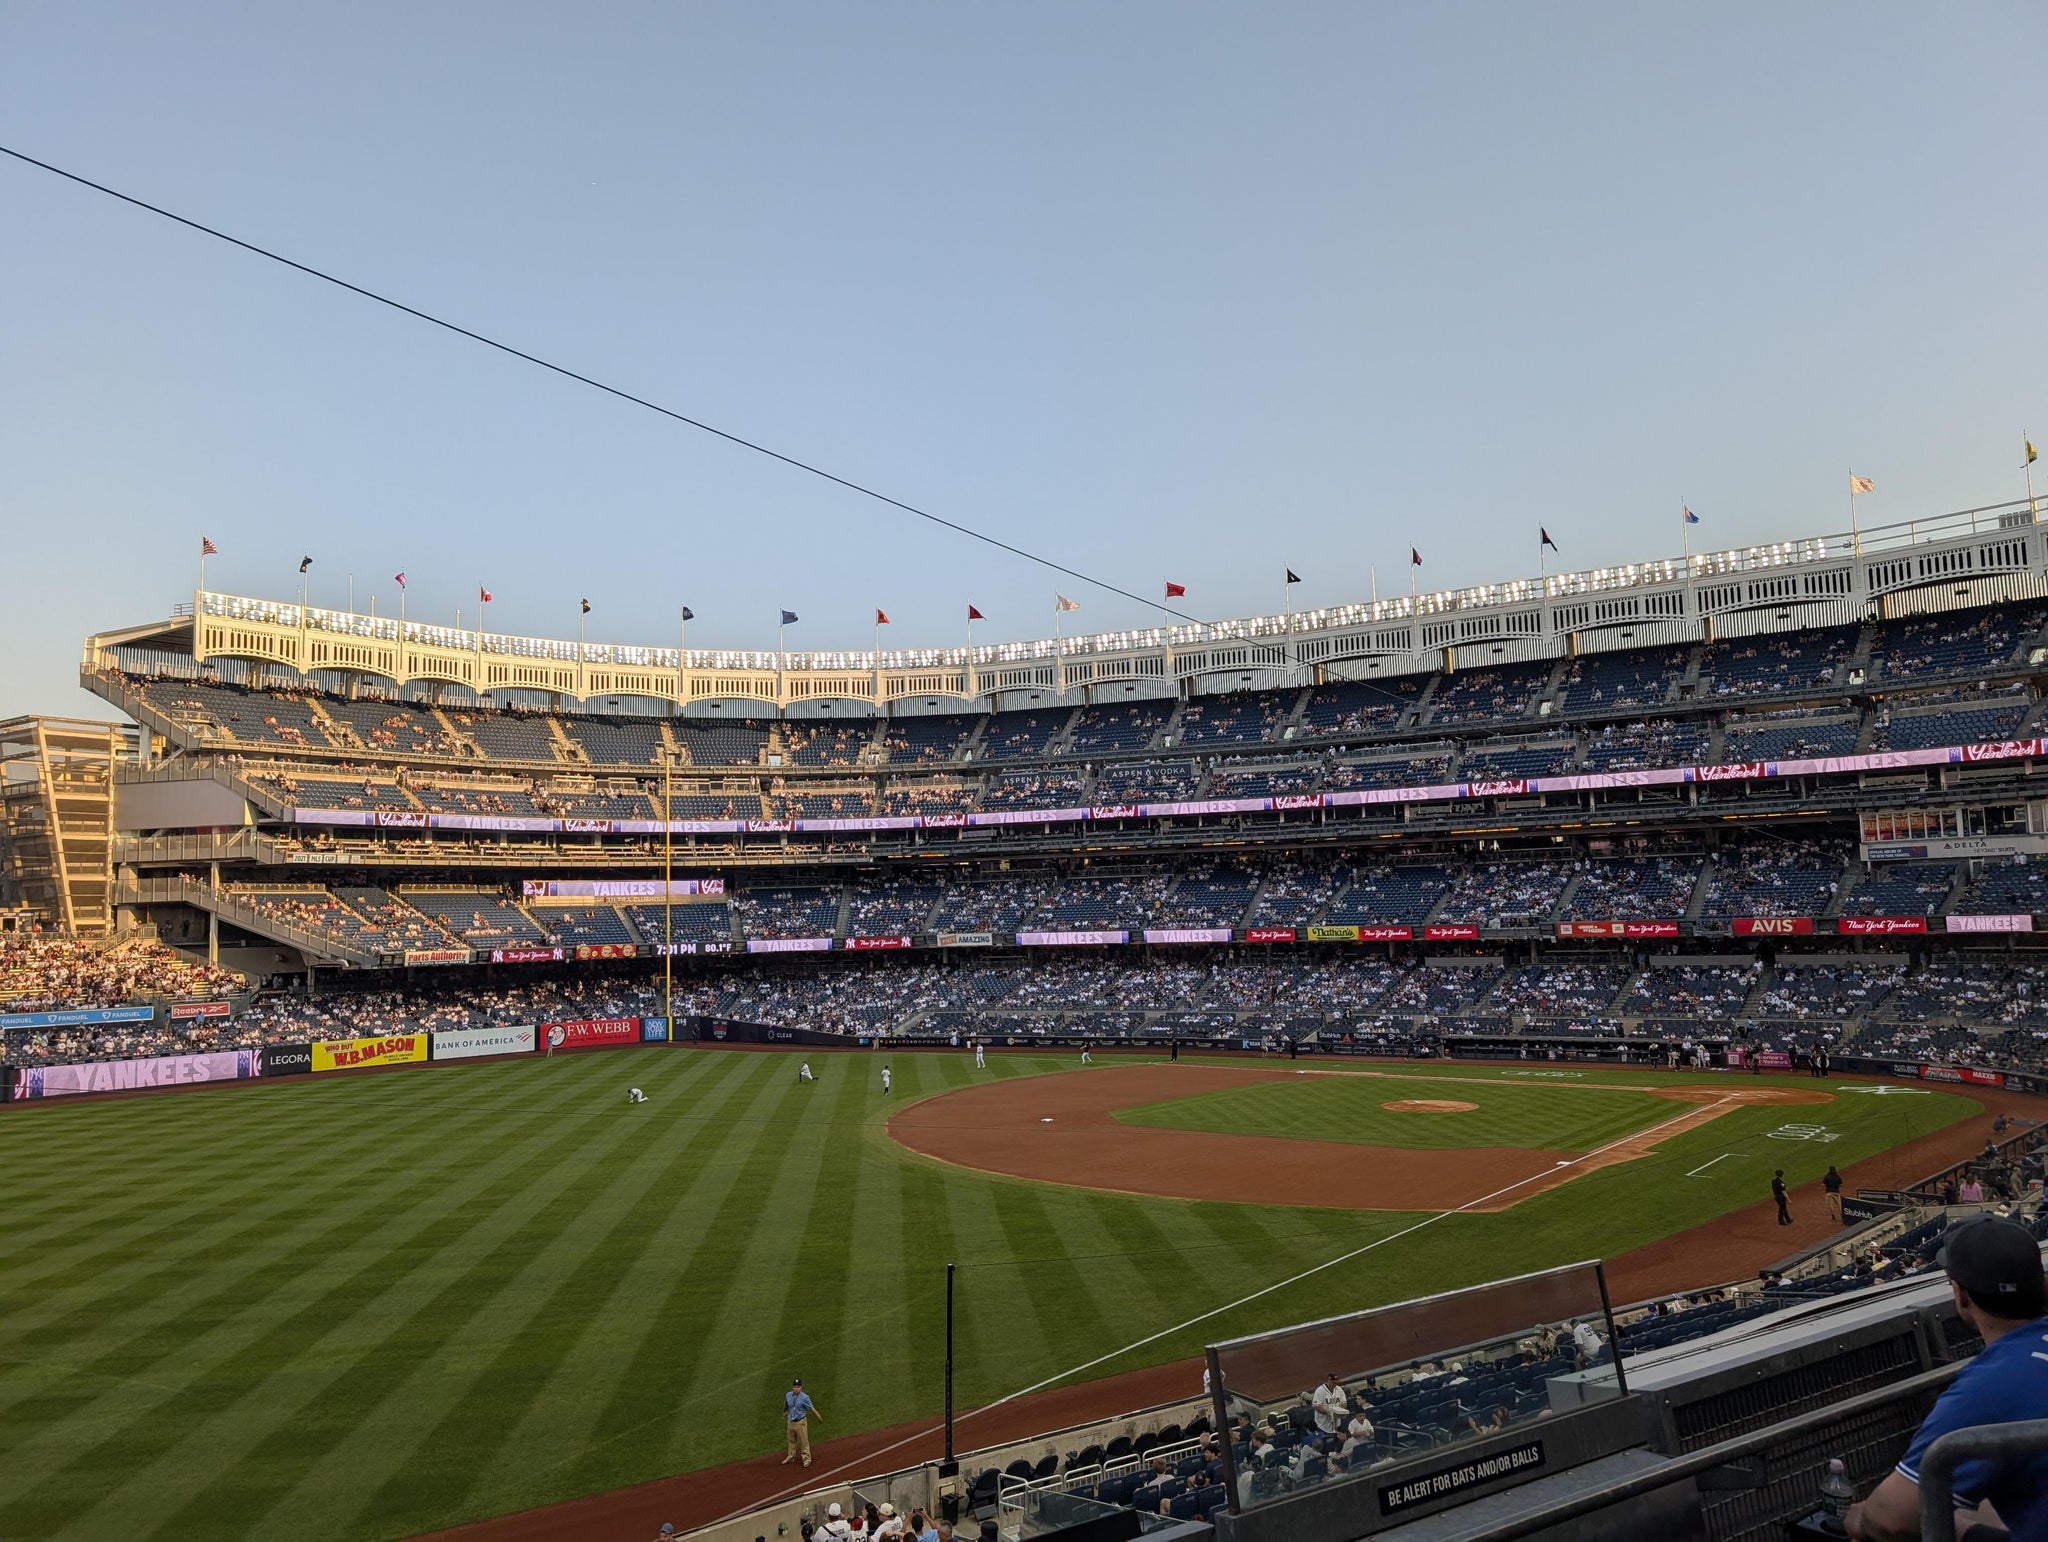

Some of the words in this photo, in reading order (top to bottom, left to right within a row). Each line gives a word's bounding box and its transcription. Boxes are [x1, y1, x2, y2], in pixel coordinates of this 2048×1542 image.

[1967, 740, 2036, 760] Yankees
[1815, 752, 1909, 773] YANKEES
[1112, 769, 1143, 778] ASPEN
[1154, 767, 1186, 776] VODKA
[1700, 763, 1759, 780] Yankees
[1003, 776, 1032, 784] ASPEN
[1568, 772, 1649, 790] YANKEES
[1472, 780, 1523, 796] Yankees
[1276, 794, 1320, 809] Yankees
[1359, 787, 1428, 804] YANKEES
[1172, 801, 1236, 815] YANKEES
[379, 813, 425, 827] Yankees
[999, 810, 1057, 823] YANKEES
[465, 817, 526, 830] YANKEES
[646, 821, 710, 832] YANKEES
[829, 818, 889, 830] YANKEES
[1954, 841, 1987, 849] DELTA
[593, 882, 656, 896] YANKEES
[1640, 925, 1653, 934] York
[1654, 924, 1677, 934] Yankees
[1751, 919, 1793, 932] AVIS
[1846, 920, 1865, 929] New
[1865, 920, 1885, 932] York
[1886, 919, 1920, 933] Yankees
[1958, 916, 2020, 930] YANKEES
[1040, 932, 1103, 944] YANKEES
[1162, 930, 1213, 942] YANKEES
[1261, 931, 1272, 940] York
[1272, 931, 1291, 940] Yankees
[1313, 927, 1354, 937] Nathan's
[1375, 929, 1387, 938] York
[1387, 929, 1408, 938] Yankees
[1441, 928, 1452, 937] York
[1452, 928, 1473, 937] Yankees
[766, 938, 814, 951] YANKEES
[958, 935, 990, 944] AMAZING
[680, 943, 697, 954] PM
[408, 953, 429, 961] Parts
[430, 951, 467, 961] Authority
[112, 1011, 141, 1019] FANDUEL
[173, 1006, 208, 1016] Reebok
[2, 1017, 33, 1025] FANDUEL
[58, 1014, 88, 1022] FANDUEL
[567, 1024, 589, 1037] F.W.
[592, 1021, 631, 1034] WEBB
[325, 1044, 339, 1053] WHO
[341, 1042, 354, 1051] BUT
[435, 1041, 460, 1050] BANK
[462, 1040, 473, 1048] OF
[475, 1037, 514, 1047] AMERICA
[270, 1053, 311, 1066] LEGORA
[73, 1054, 212, 1093] YANKEES
[1972, 1071, 1996, 1080] MAXXIS
[1843, 1207, 1873, 1219] StubHub
[1388, 1489, 1402, 1507] BE
[1403, 1481, 1432, 1503] ALERT
[1432, 1475, 1452, 1494] FOR
[1451, 1466, 1476, 1488] BATS
[1477, 1455, 1511, 1479] AND/OR
[1511, 1446, 1539, 1468] BALLS
